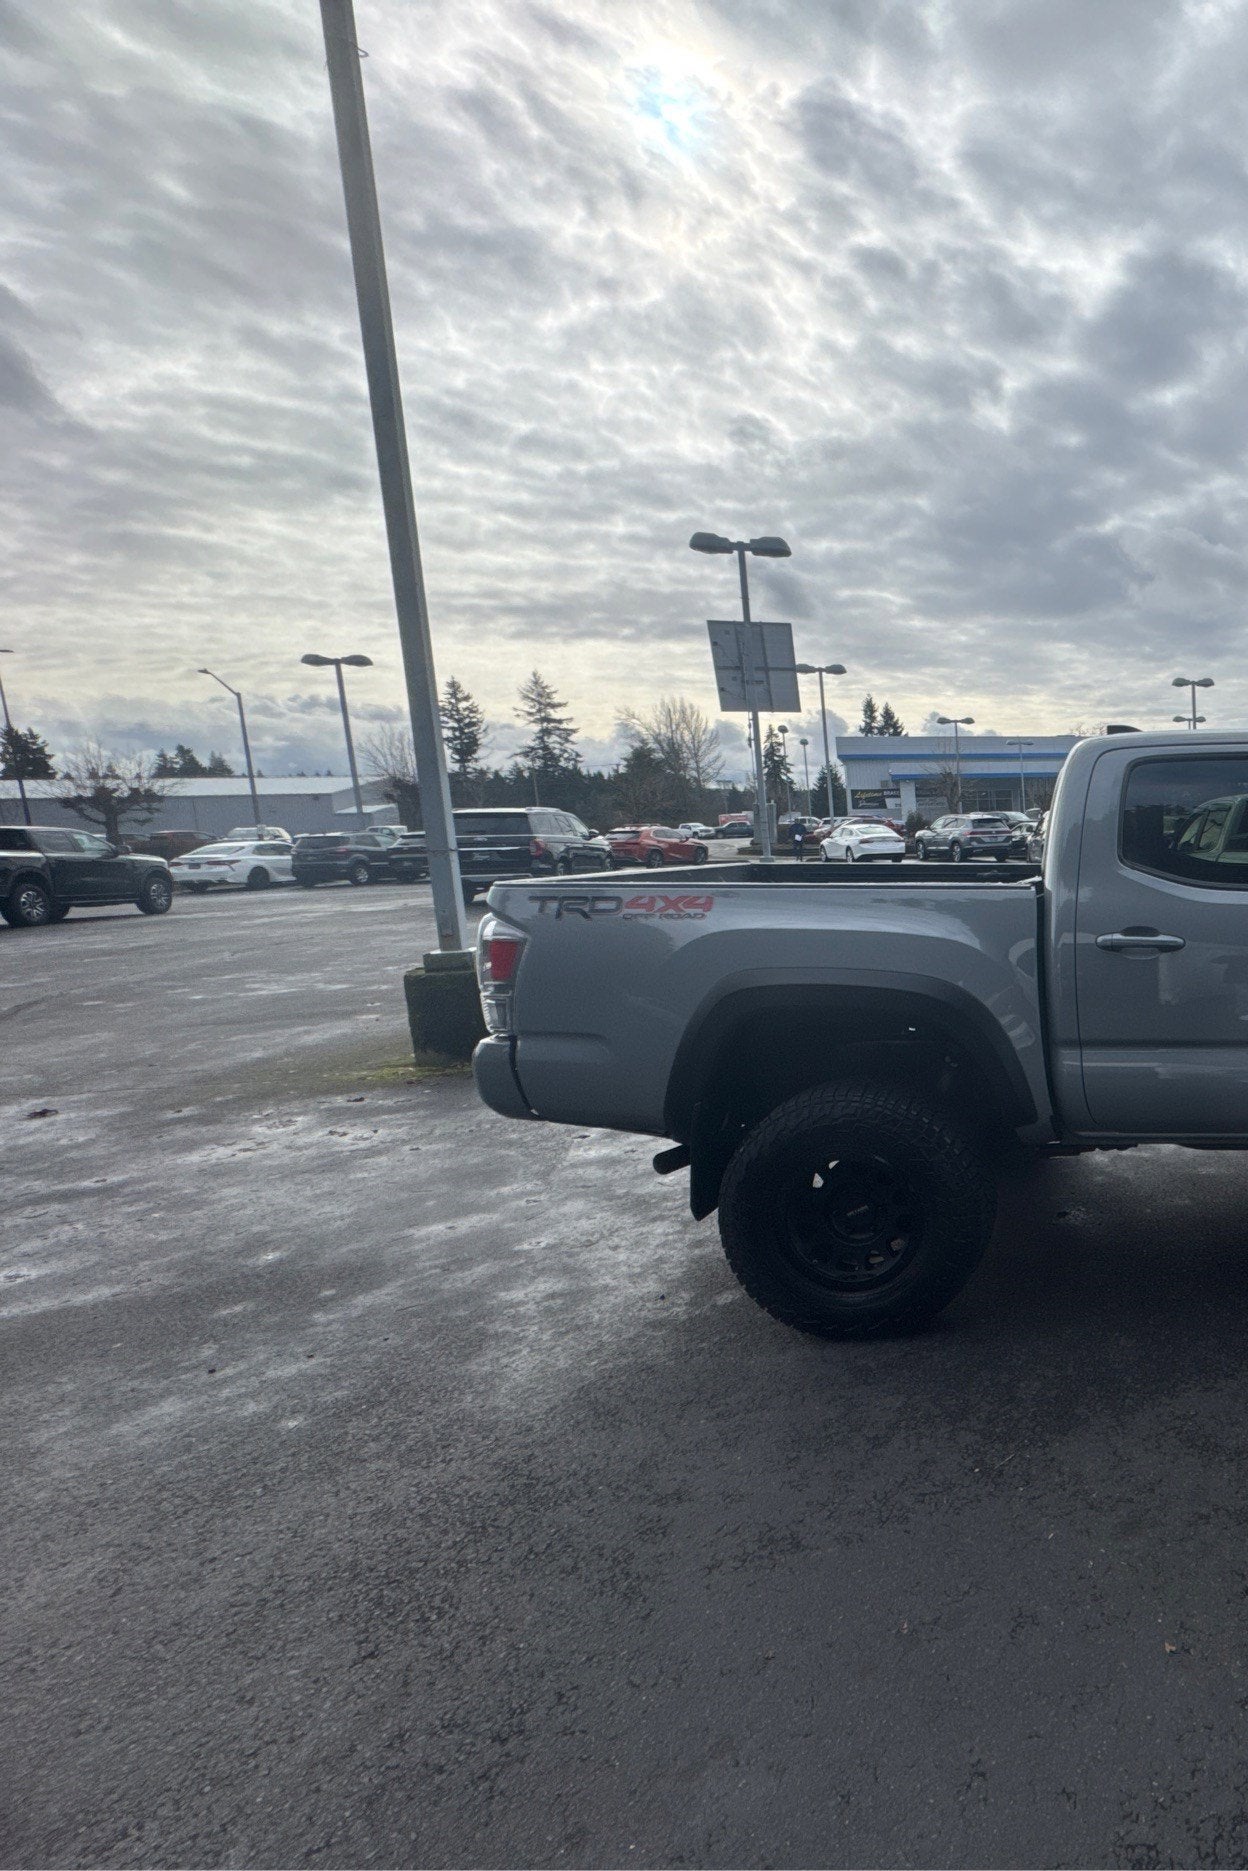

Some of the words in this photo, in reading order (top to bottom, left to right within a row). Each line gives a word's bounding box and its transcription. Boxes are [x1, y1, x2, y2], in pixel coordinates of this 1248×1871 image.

[529, 895, 623, 919] TRD
[622, 912, 656, 920] OFF
[658, 912, 706, 920] ROAD
